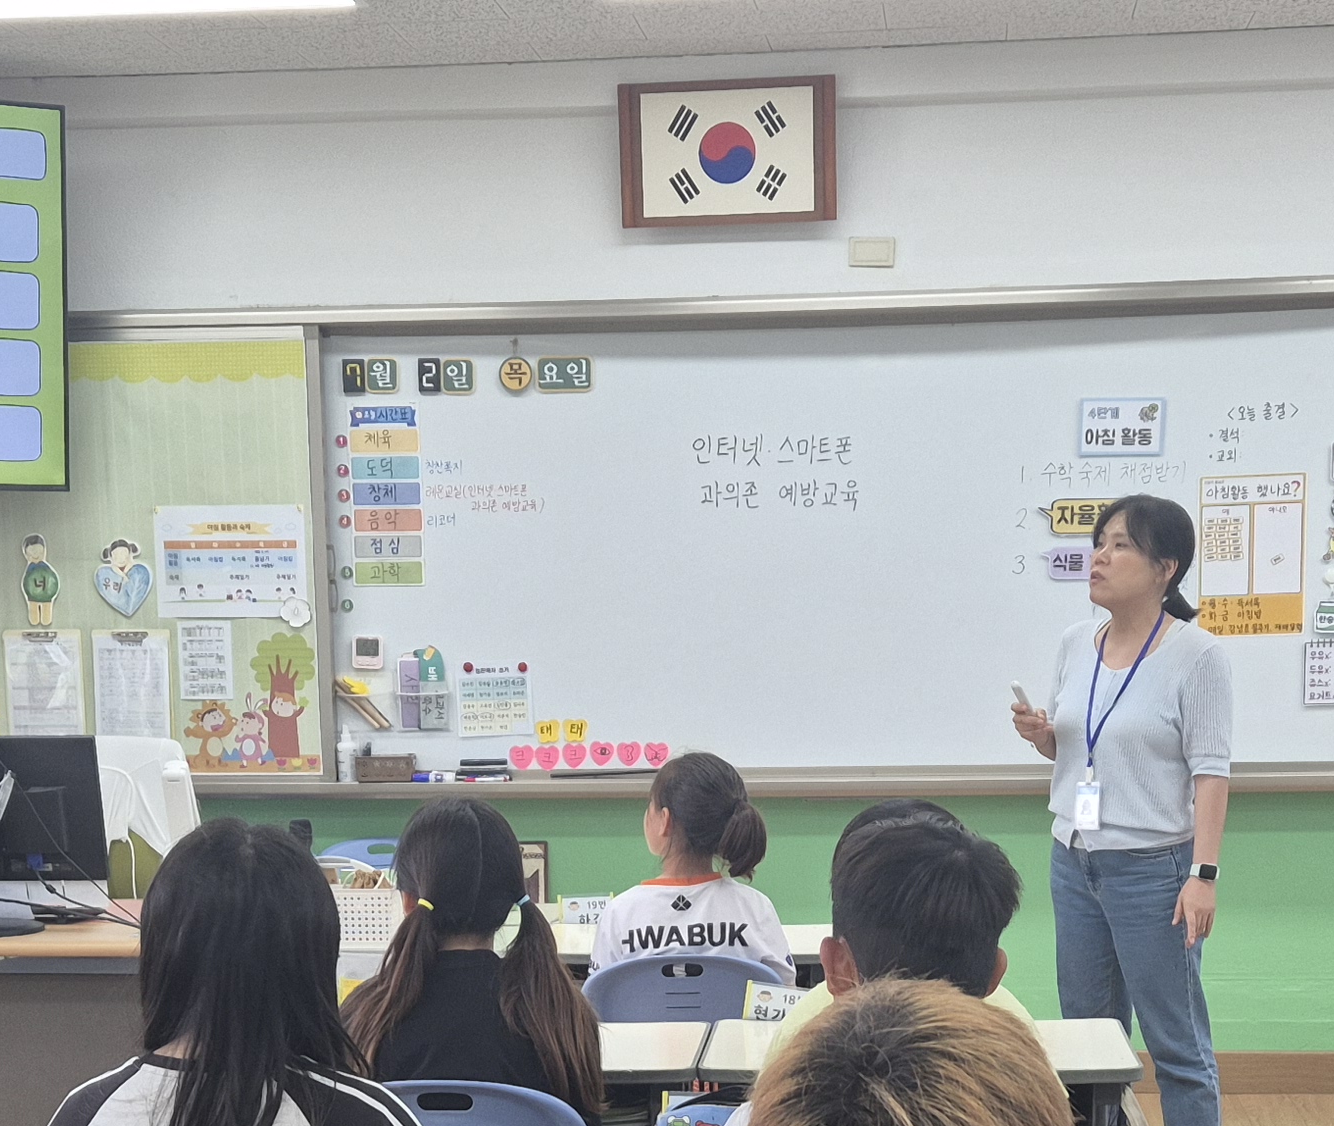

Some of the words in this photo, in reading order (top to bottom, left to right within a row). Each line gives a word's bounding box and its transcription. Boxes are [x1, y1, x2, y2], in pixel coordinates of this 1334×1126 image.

[422, 359, 468, 389] 2일
[364, 429, 392, 449] 체육
[1085, 428, 1115, 446] 아침
[1121, 427, 1153, 446] 활동
[367, 457, 393, 478] 도덕
[1041, 462, 1073, 488] 수학
[1078, 461, 1110, 488] 숙제
[368, 484, 397, 502] 창체
[700, 480, 759, 509] 과의존
[778, 479, 860, 511] 예방교육
[367, 510, 399, 530] 음악
[370, 537, 400, 555] 점심
[1052, 553, 1084, 572] 식물
[370, 564, 401, 581] 과학
[34, 578, 47, 590] 너
[102, 578, 123, 594] 우리
